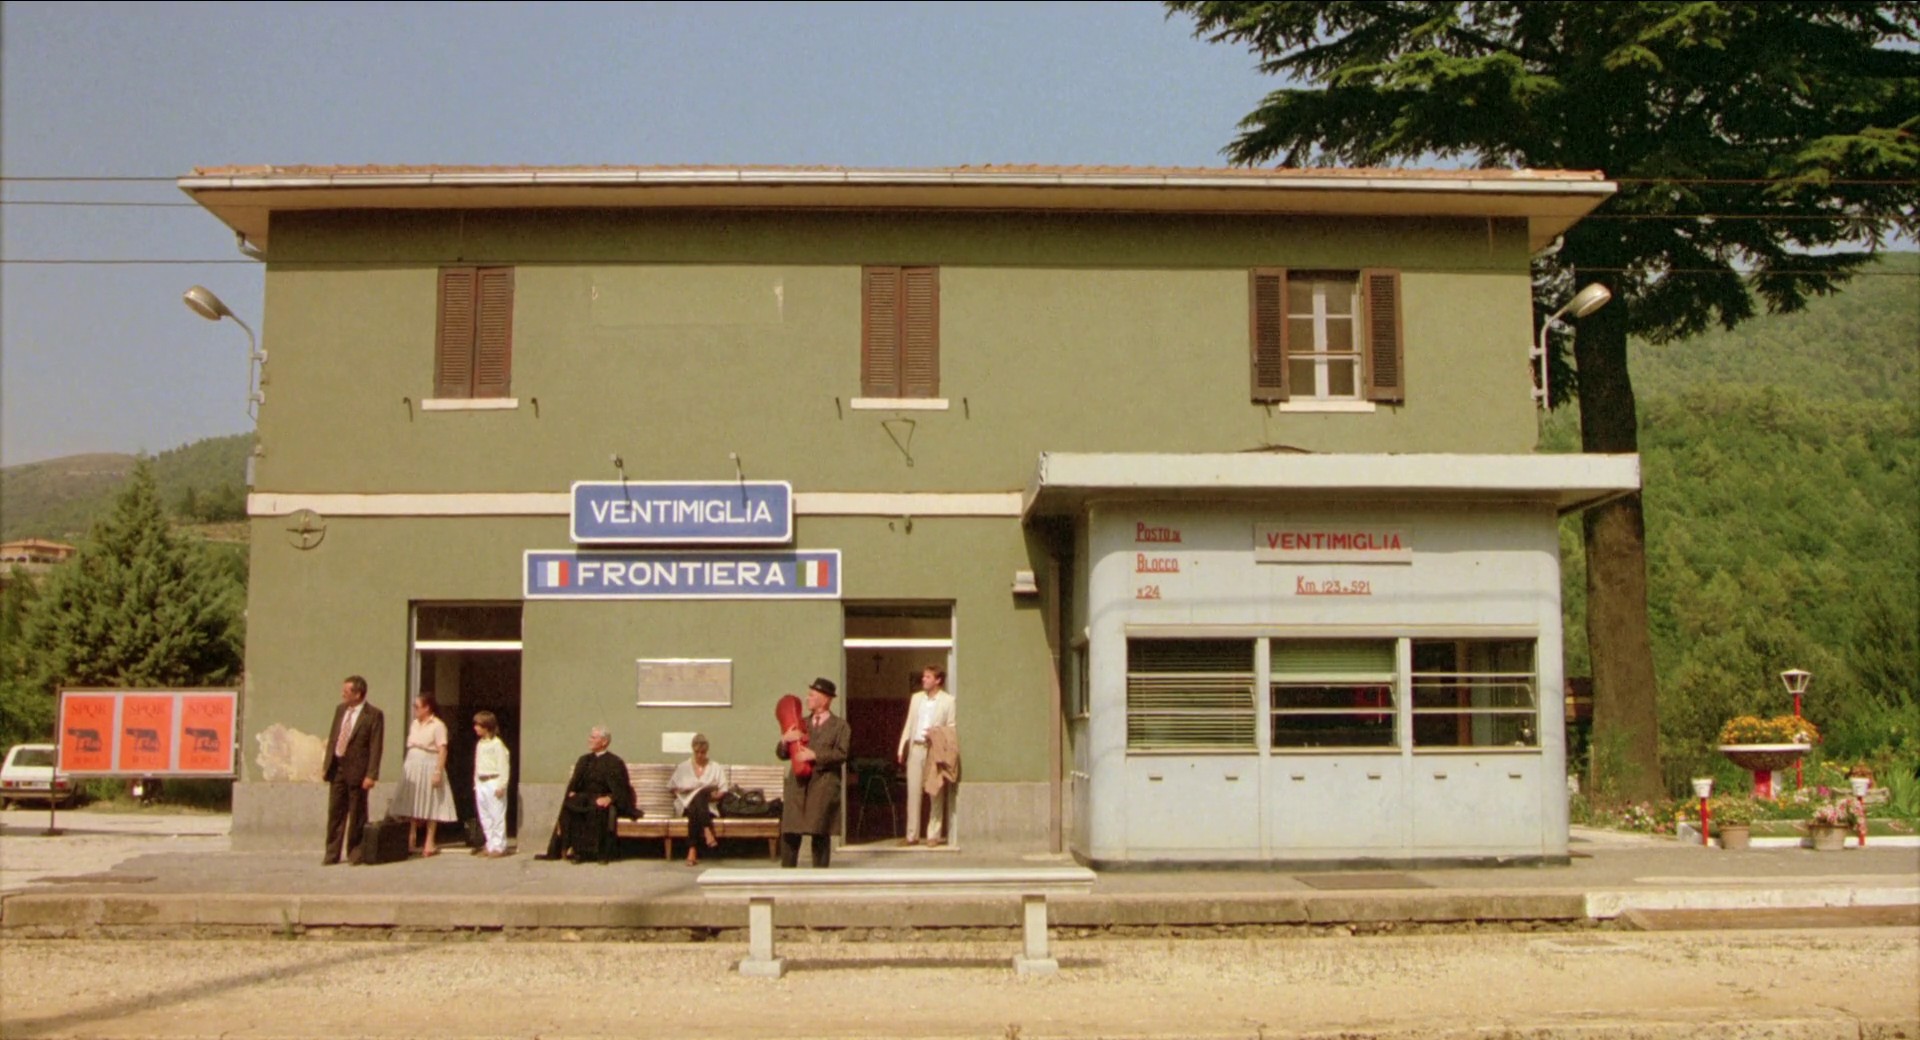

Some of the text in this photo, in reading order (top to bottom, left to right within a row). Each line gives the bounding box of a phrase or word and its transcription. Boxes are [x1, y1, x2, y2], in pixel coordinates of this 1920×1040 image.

[590, 499, 773, 524] VENTIMIGLIA
[1266, 531, 1402, 551] VENTIMIGLIA
[576, 561, 786, 587] FRONTIERA
[71, 703, 107, 719] SPQR
[129, 703, 166, 719] SPQR
[187, 703, 225, 719] SPQR
